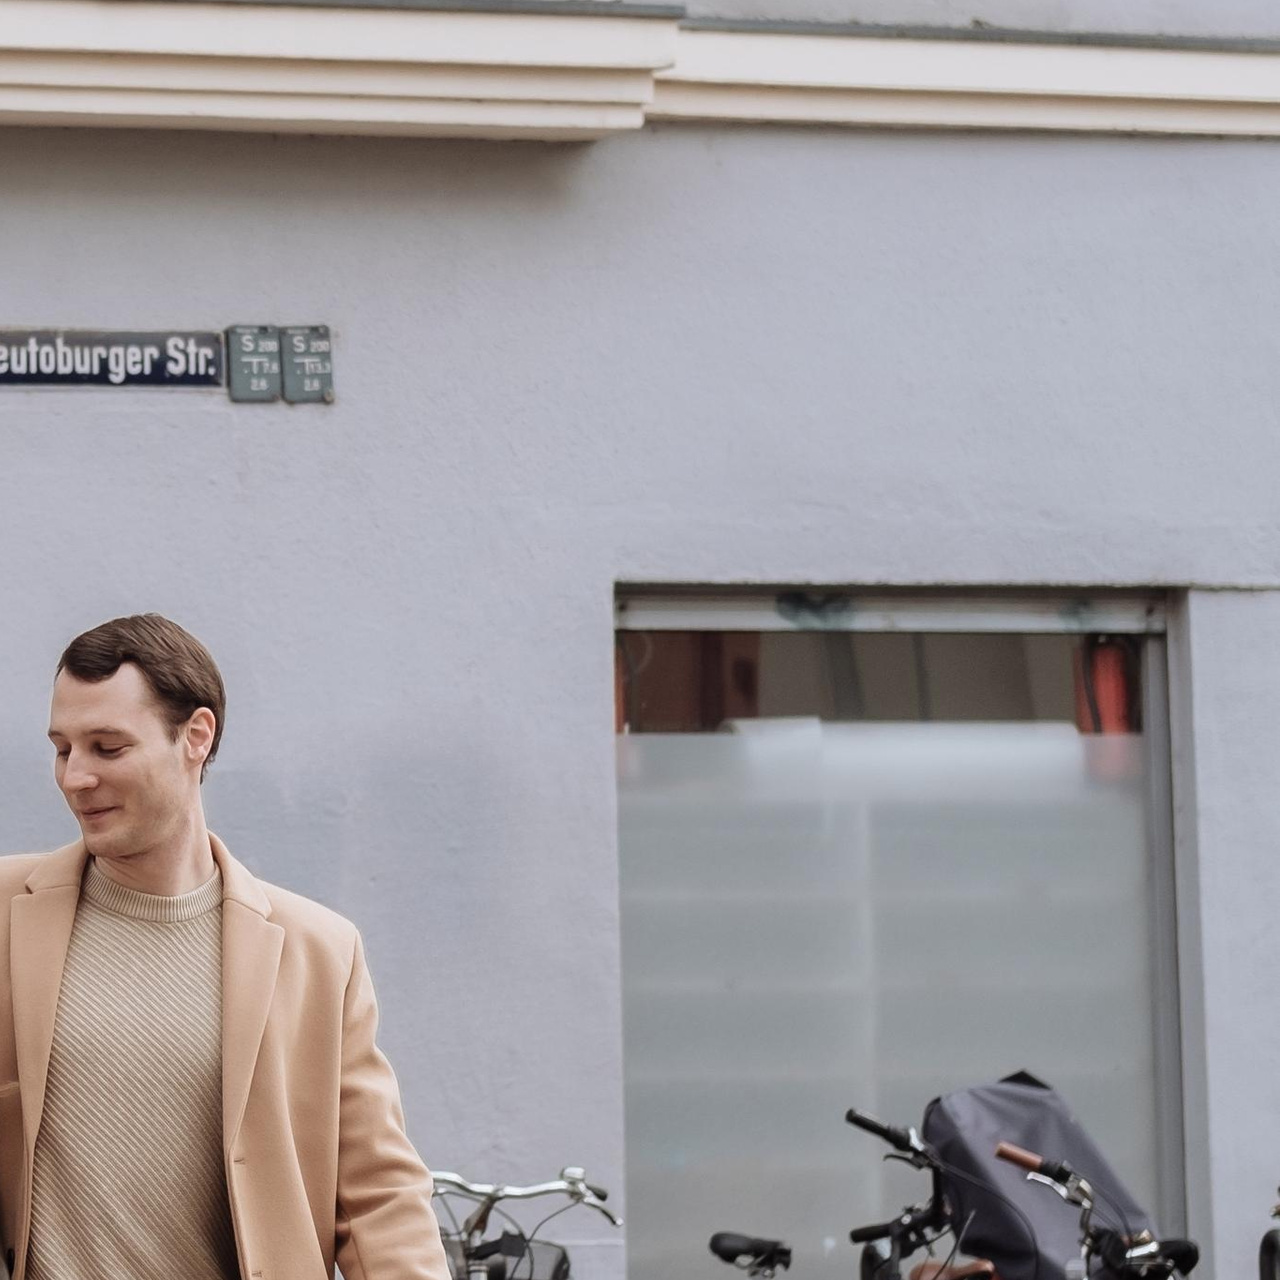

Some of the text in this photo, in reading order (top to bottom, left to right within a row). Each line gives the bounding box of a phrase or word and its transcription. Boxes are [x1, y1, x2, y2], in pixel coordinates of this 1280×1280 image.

[241, 334, 255, 352] S
[292, 336, 306, 353] S
[165, 336, 216, 376] Str.
